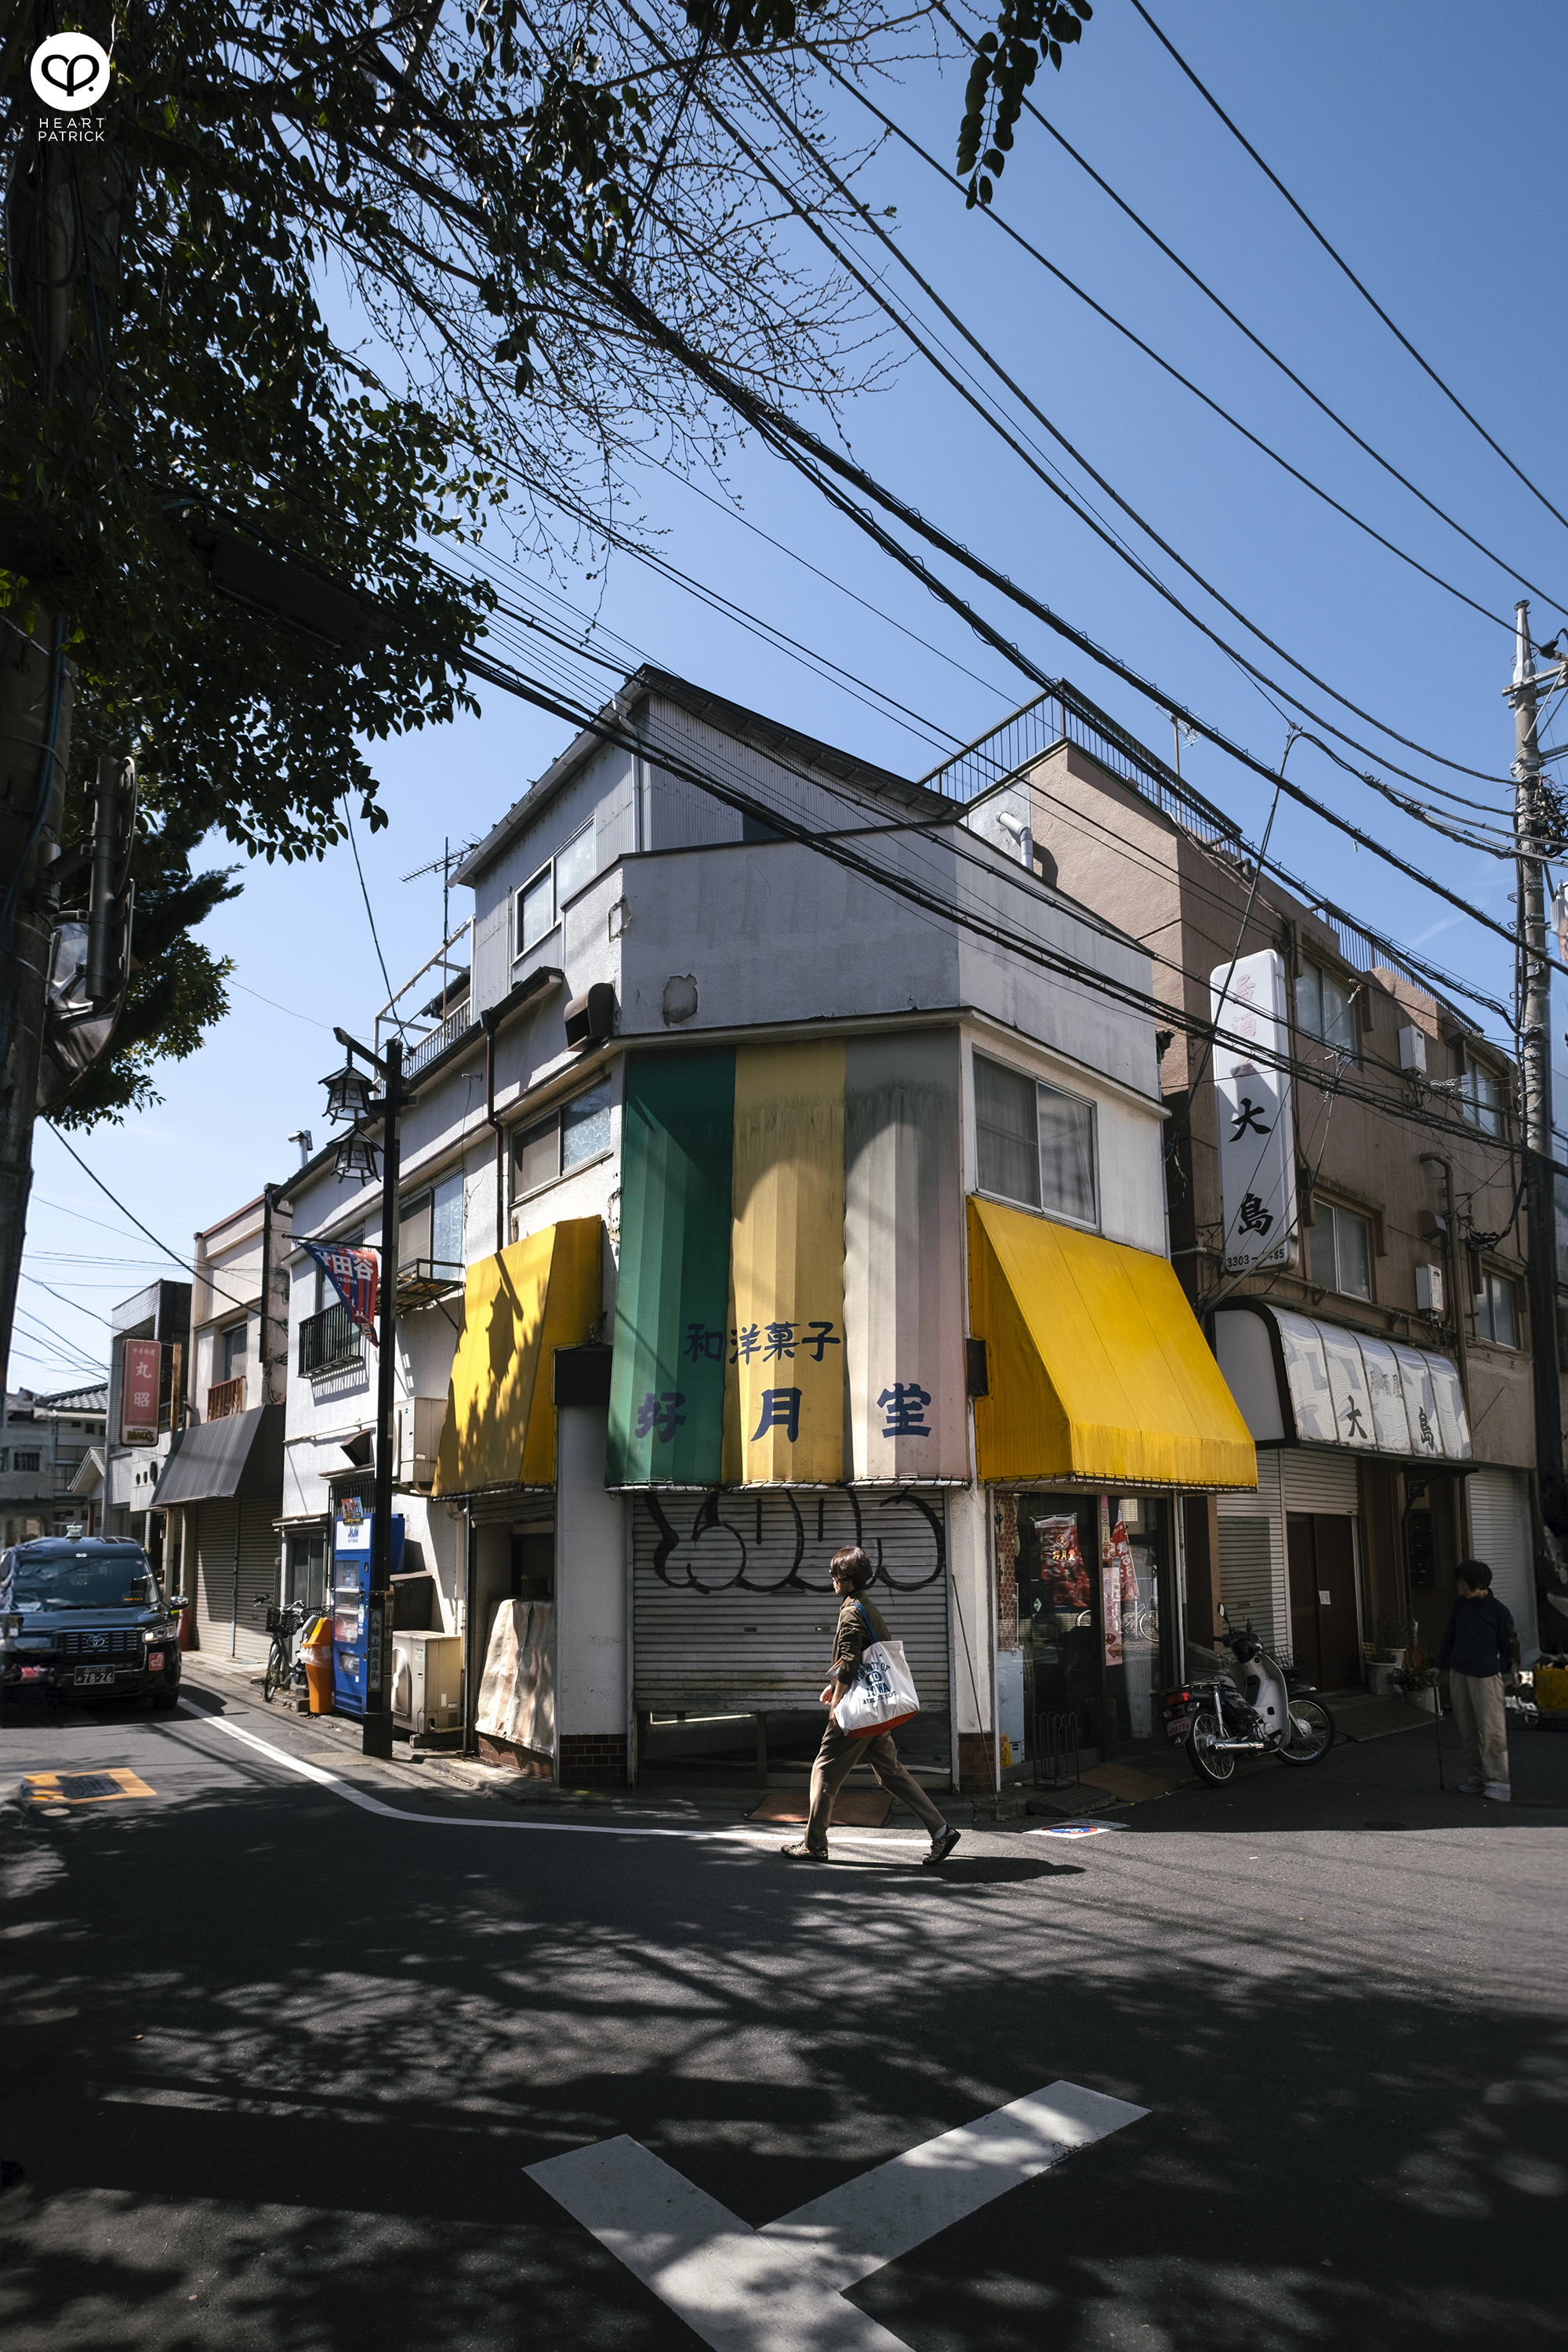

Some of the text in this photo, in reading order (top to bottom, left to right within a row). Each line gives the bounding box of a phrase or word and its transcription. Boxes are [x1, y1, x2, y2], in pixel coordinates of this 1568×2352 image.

[1228, 1098, 1274, 1237] 大島
[1227, 1248, 1284, 1268] 3303-85
[682, 1320, 841, 1365] 和洋菓子
[134, 1361, 152, 1407] 丸昭
[634, 1382, 932, 1444] 好月堂
[1345, 1394, 1435, 1451] 大島
[1052, 1548, 1076, 1561] 好月堂
[371, 1616, 380, 1683] 八幡山商店街
[880, 1662, 891, 1672] OF
[83, 1672, 112, 1683] 78-26
[866, 1682, 891, 1697] IOWA
